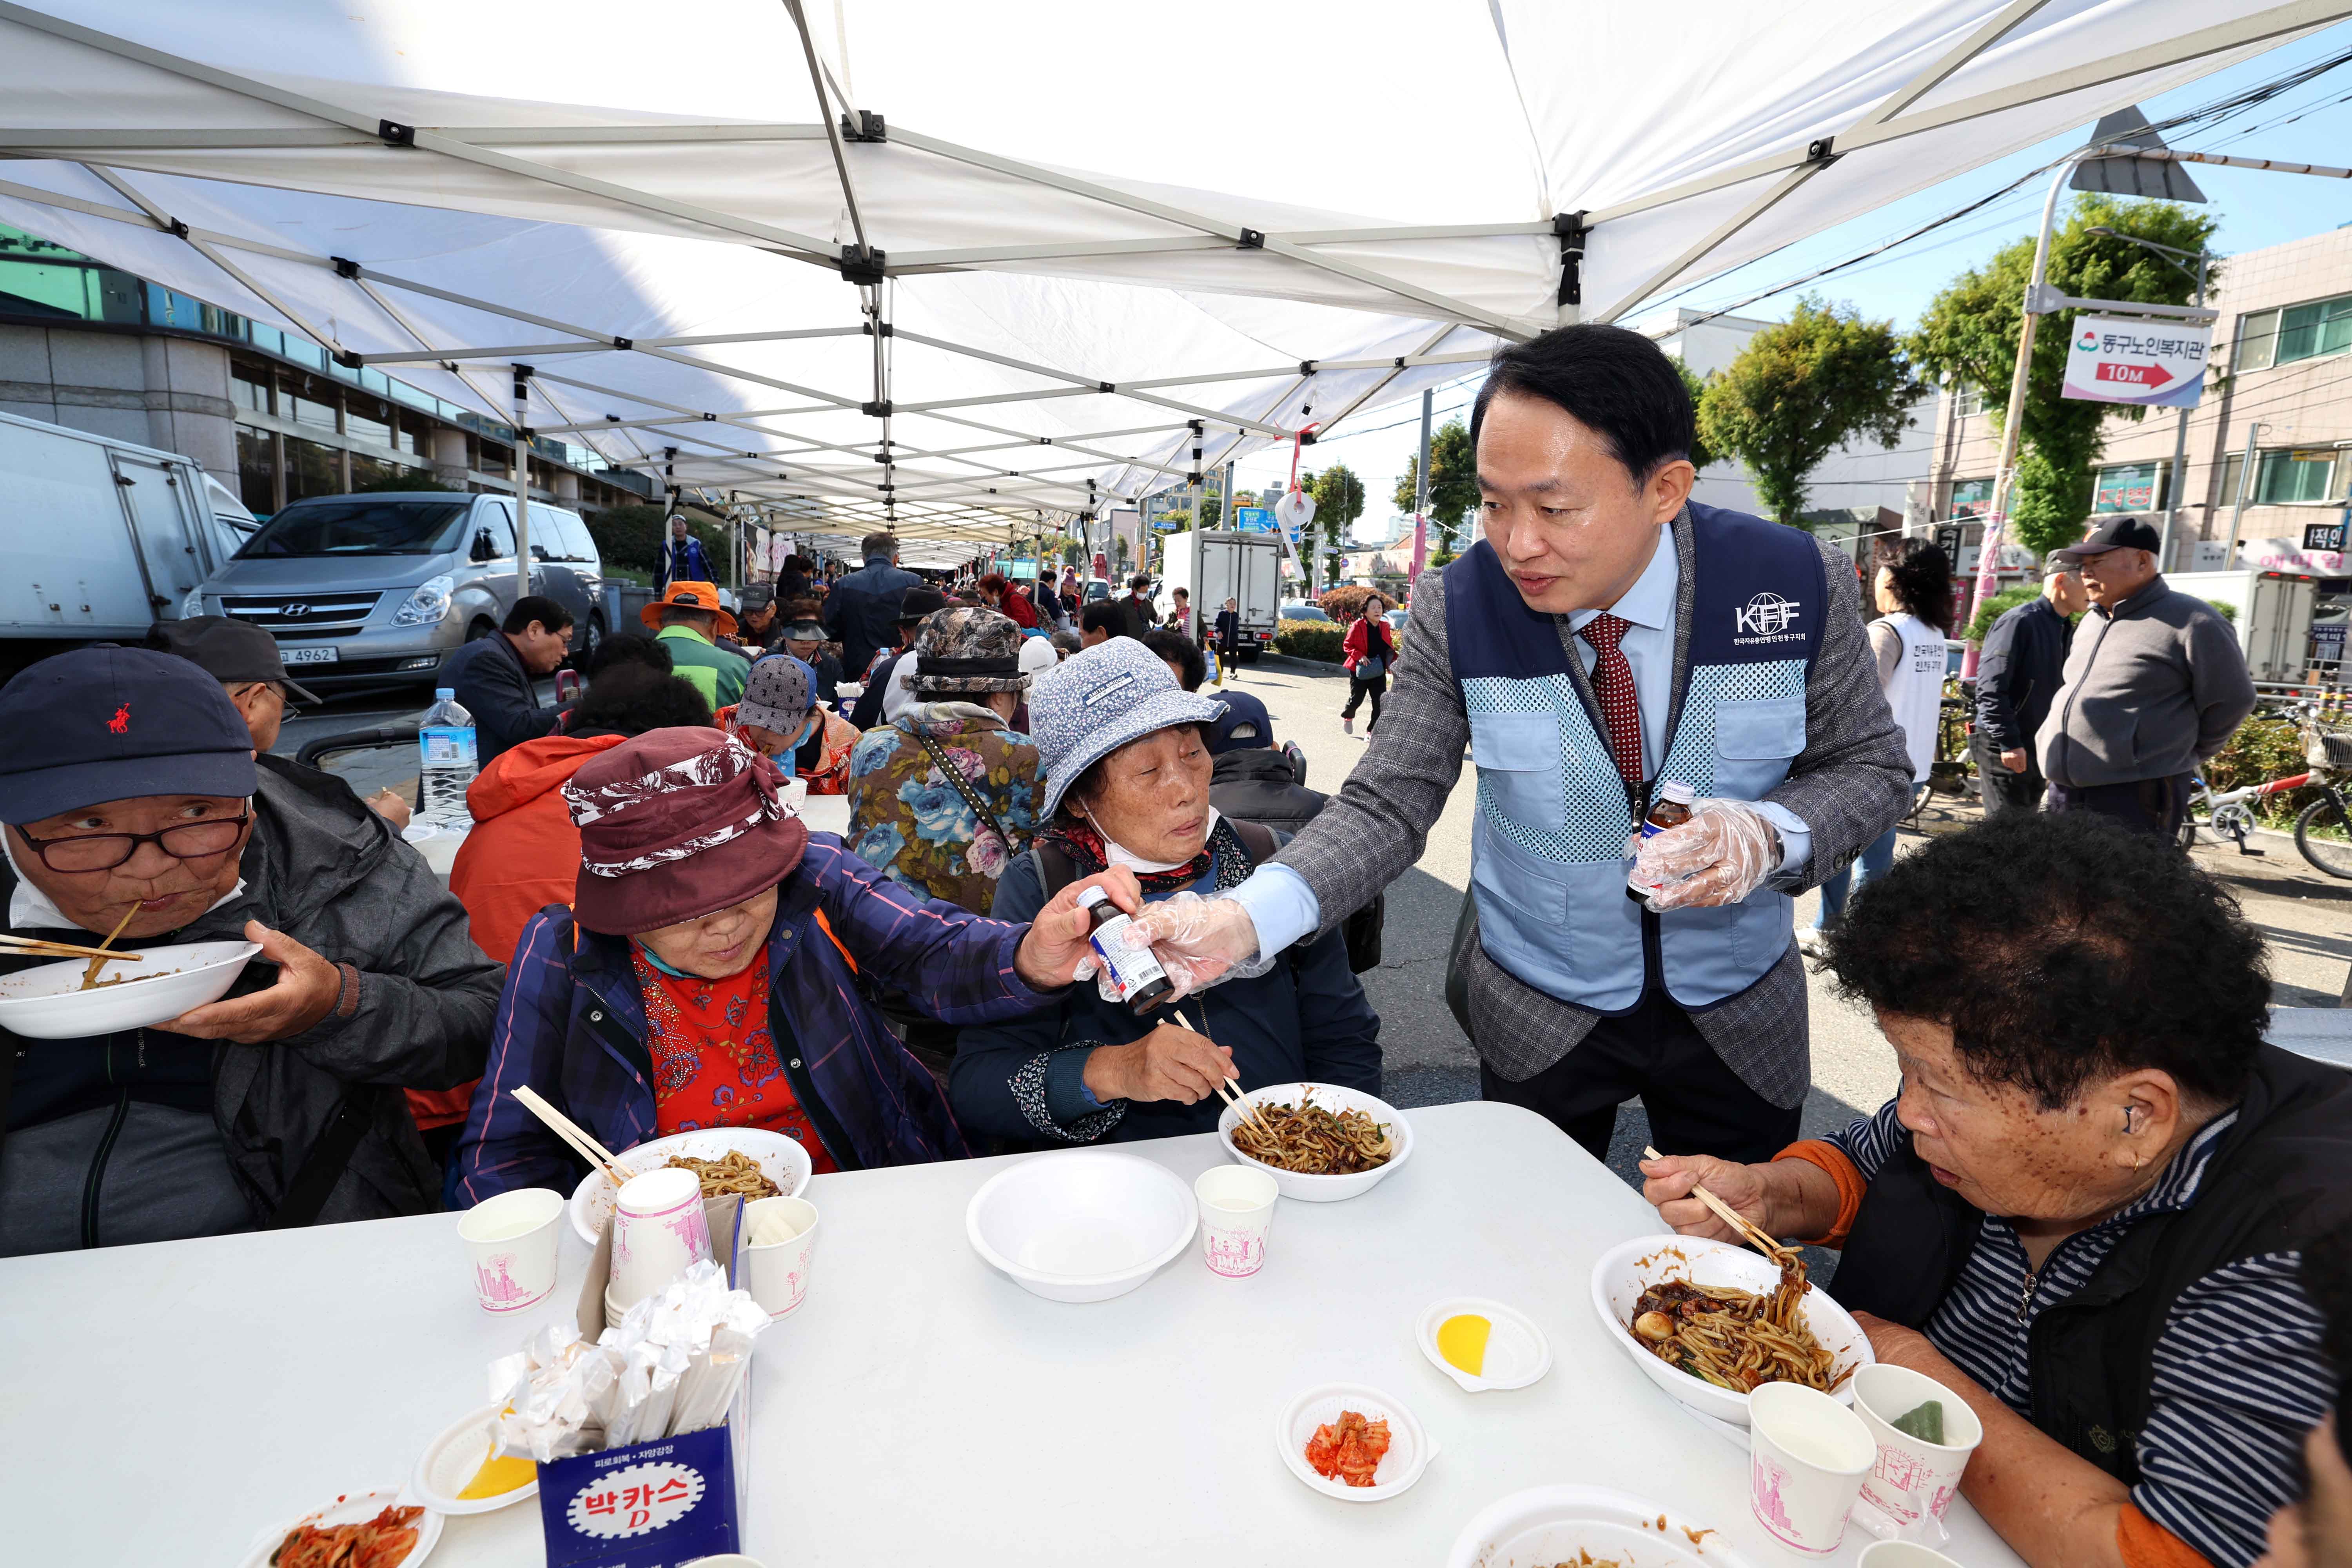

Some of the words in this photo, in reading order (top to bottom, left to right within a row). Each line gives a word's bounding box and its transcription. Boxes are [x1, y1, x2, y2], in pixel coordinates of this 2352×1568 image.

[2103, 334, 2205, 360] 동구노인복지관
[2100, 486, 2152, 507] 다방
[1734, 636, 1771, 645] 한국자유총연맹
[1771, 633, 1806, 642] 인천동구지회
[295, 650, 330, 661] 4962
[1089, 686, 1105, 698] SMITH
[1105, 675, 1126, 688] BRIDGE
[594, 1454, 630, 1468] 피로회복
[638, 1445, 674, 1459] 자양강장
[586, 1477, 688, 1515] 박카스
[628, 1509, 651, 1530] D
